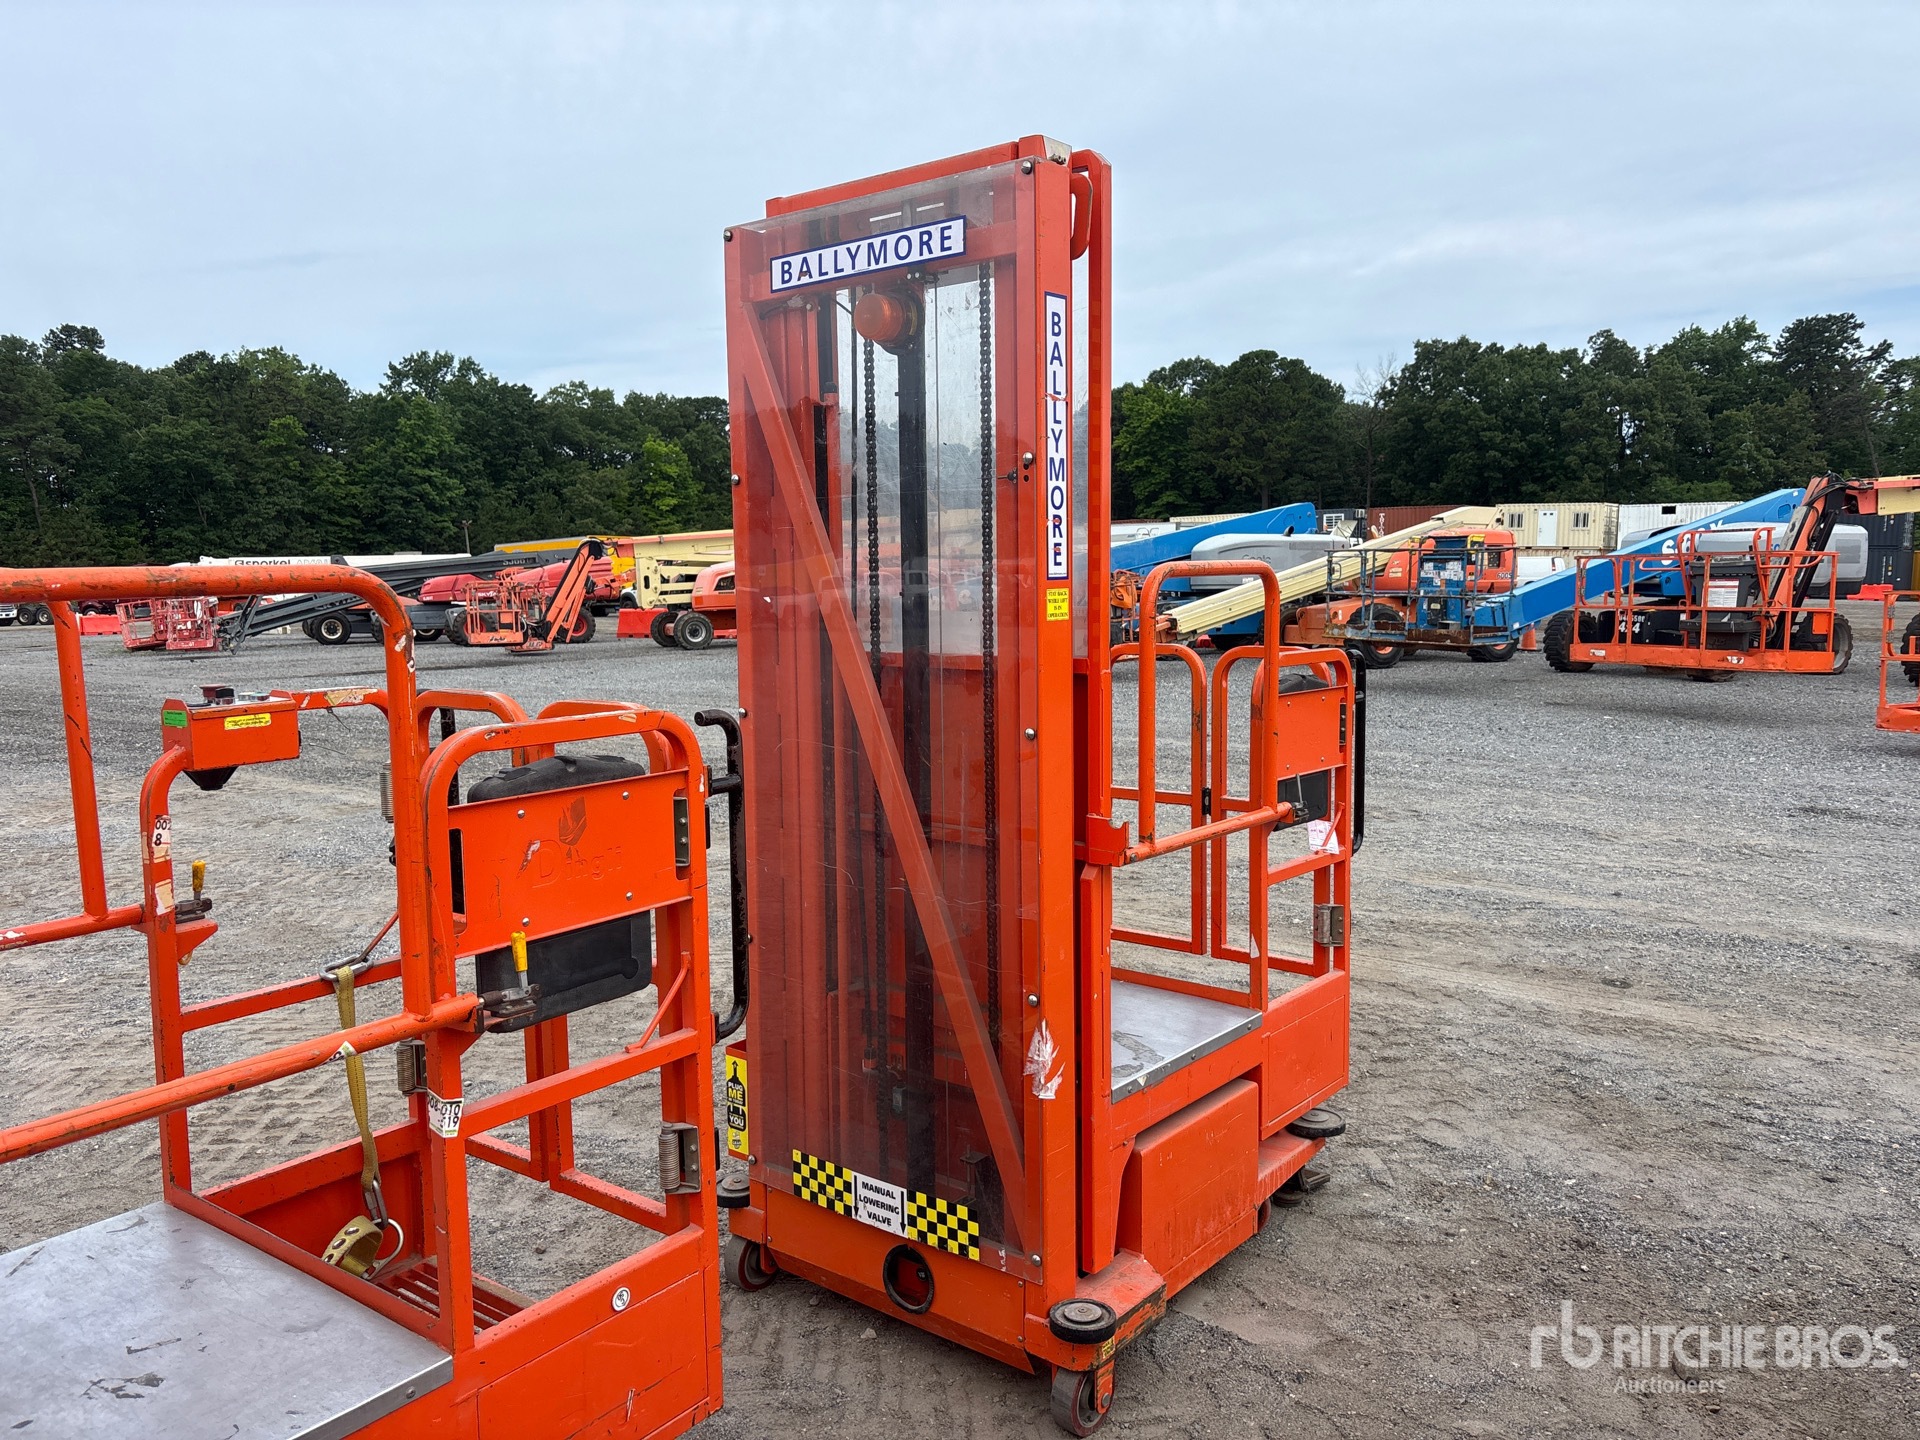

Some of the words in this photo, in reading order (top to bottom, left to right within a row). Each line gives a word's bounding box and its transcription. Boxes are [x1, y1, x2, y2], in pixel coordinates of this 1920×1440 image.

[780, 224, 953, 285] BALLYMORE
[1049, 310, 1066, 567] BALLYMORE
[727, 1081, 744, 1091] PLUG
[728, 1088, 744, 1101] ME
[729, 1114, 744, 1127] YOU
[861, 1180, 897, 1200] MANUAL
[858, 1193, 900, 1215] LOWERING
[866, 1210, 892, 1227] VALVE
